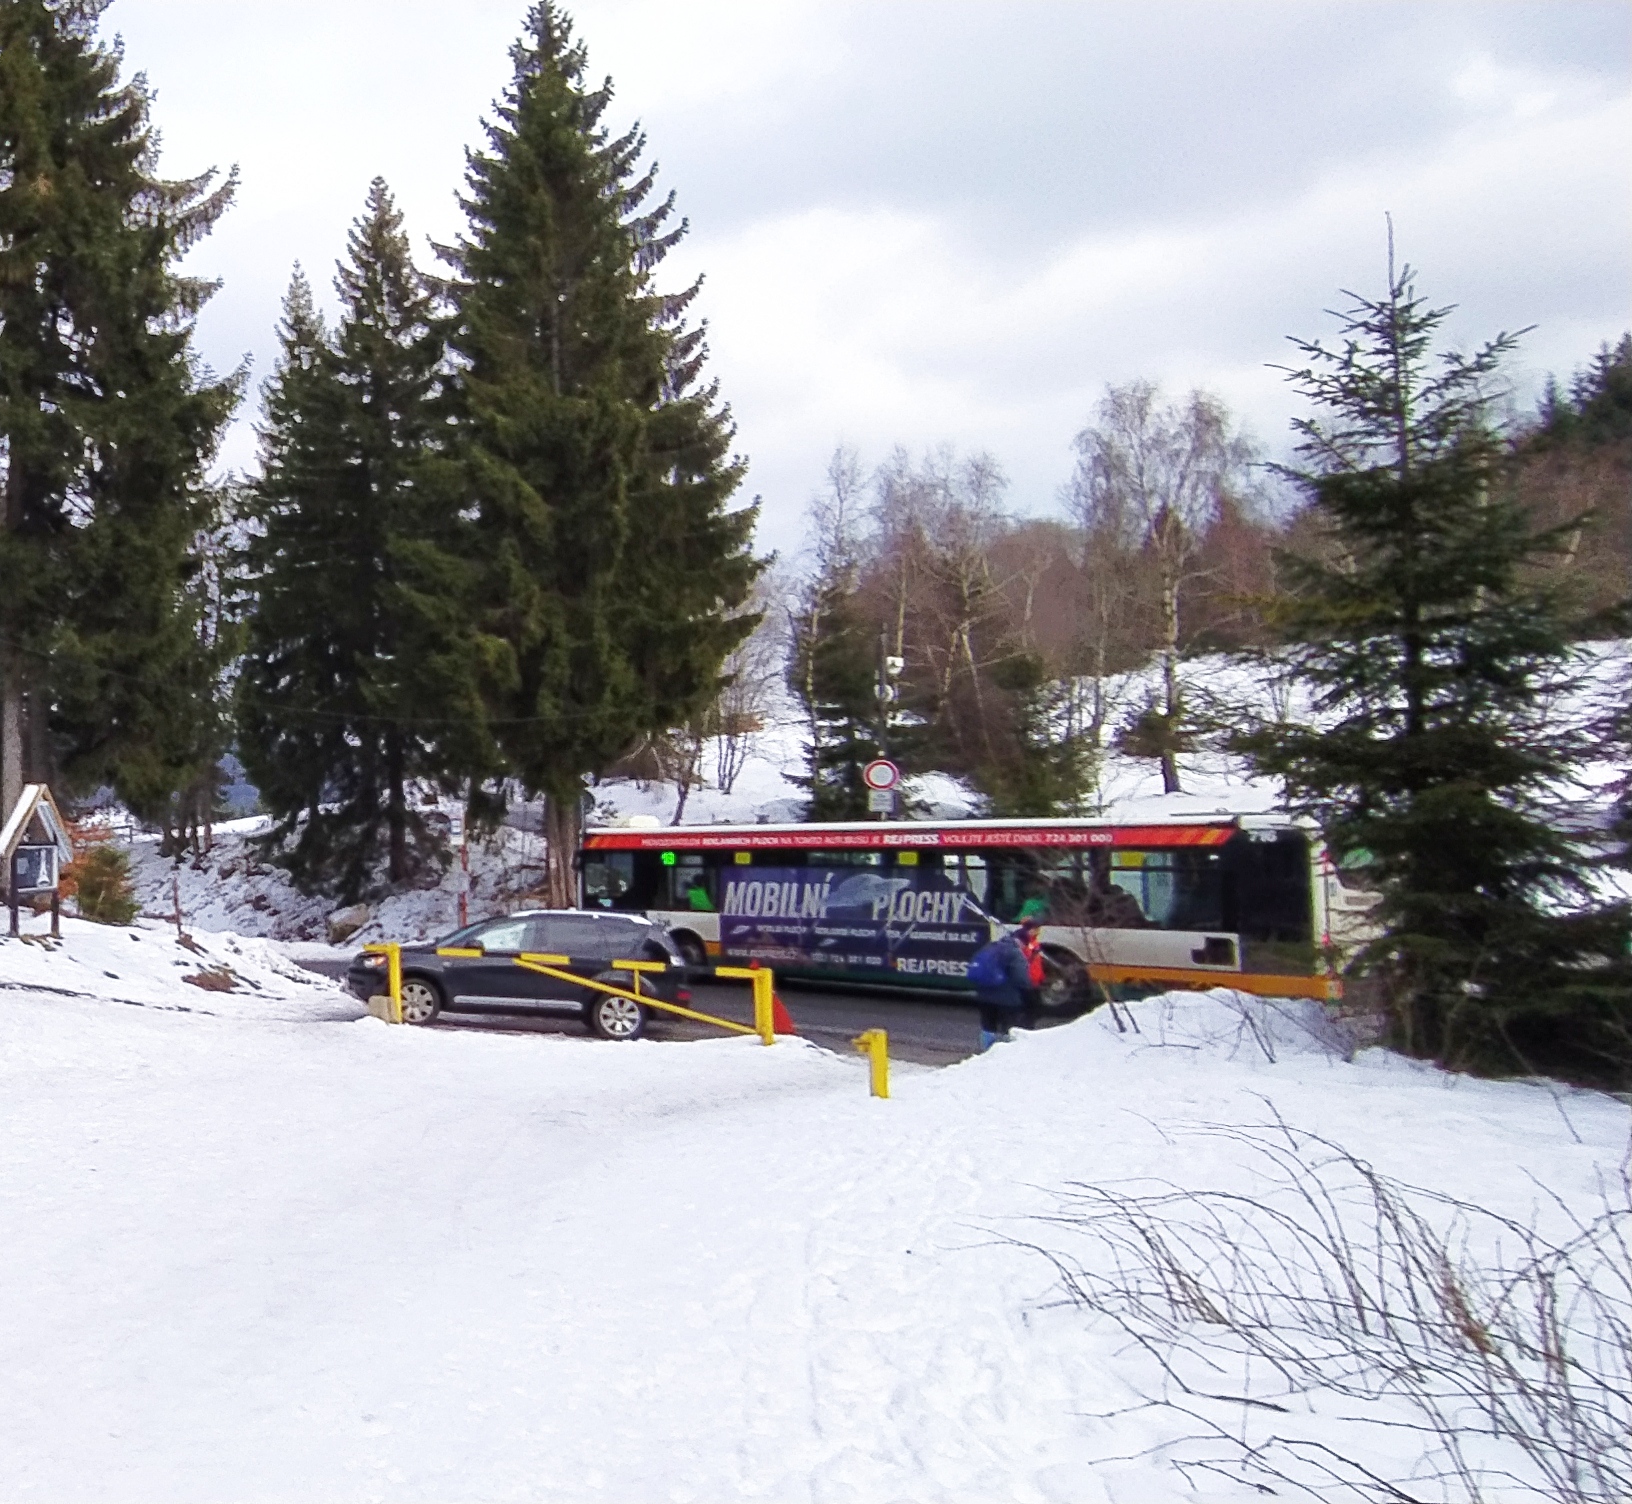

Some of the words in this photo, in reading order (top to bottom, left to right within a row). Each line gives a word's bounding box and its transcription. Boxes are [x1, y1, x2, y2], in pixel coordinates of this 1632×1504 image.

[1045, 833, 1066, 843] 724
[724, 872, 835, 919] MOBILNÍ
[872, 890, 967, 924] PLOCHY
